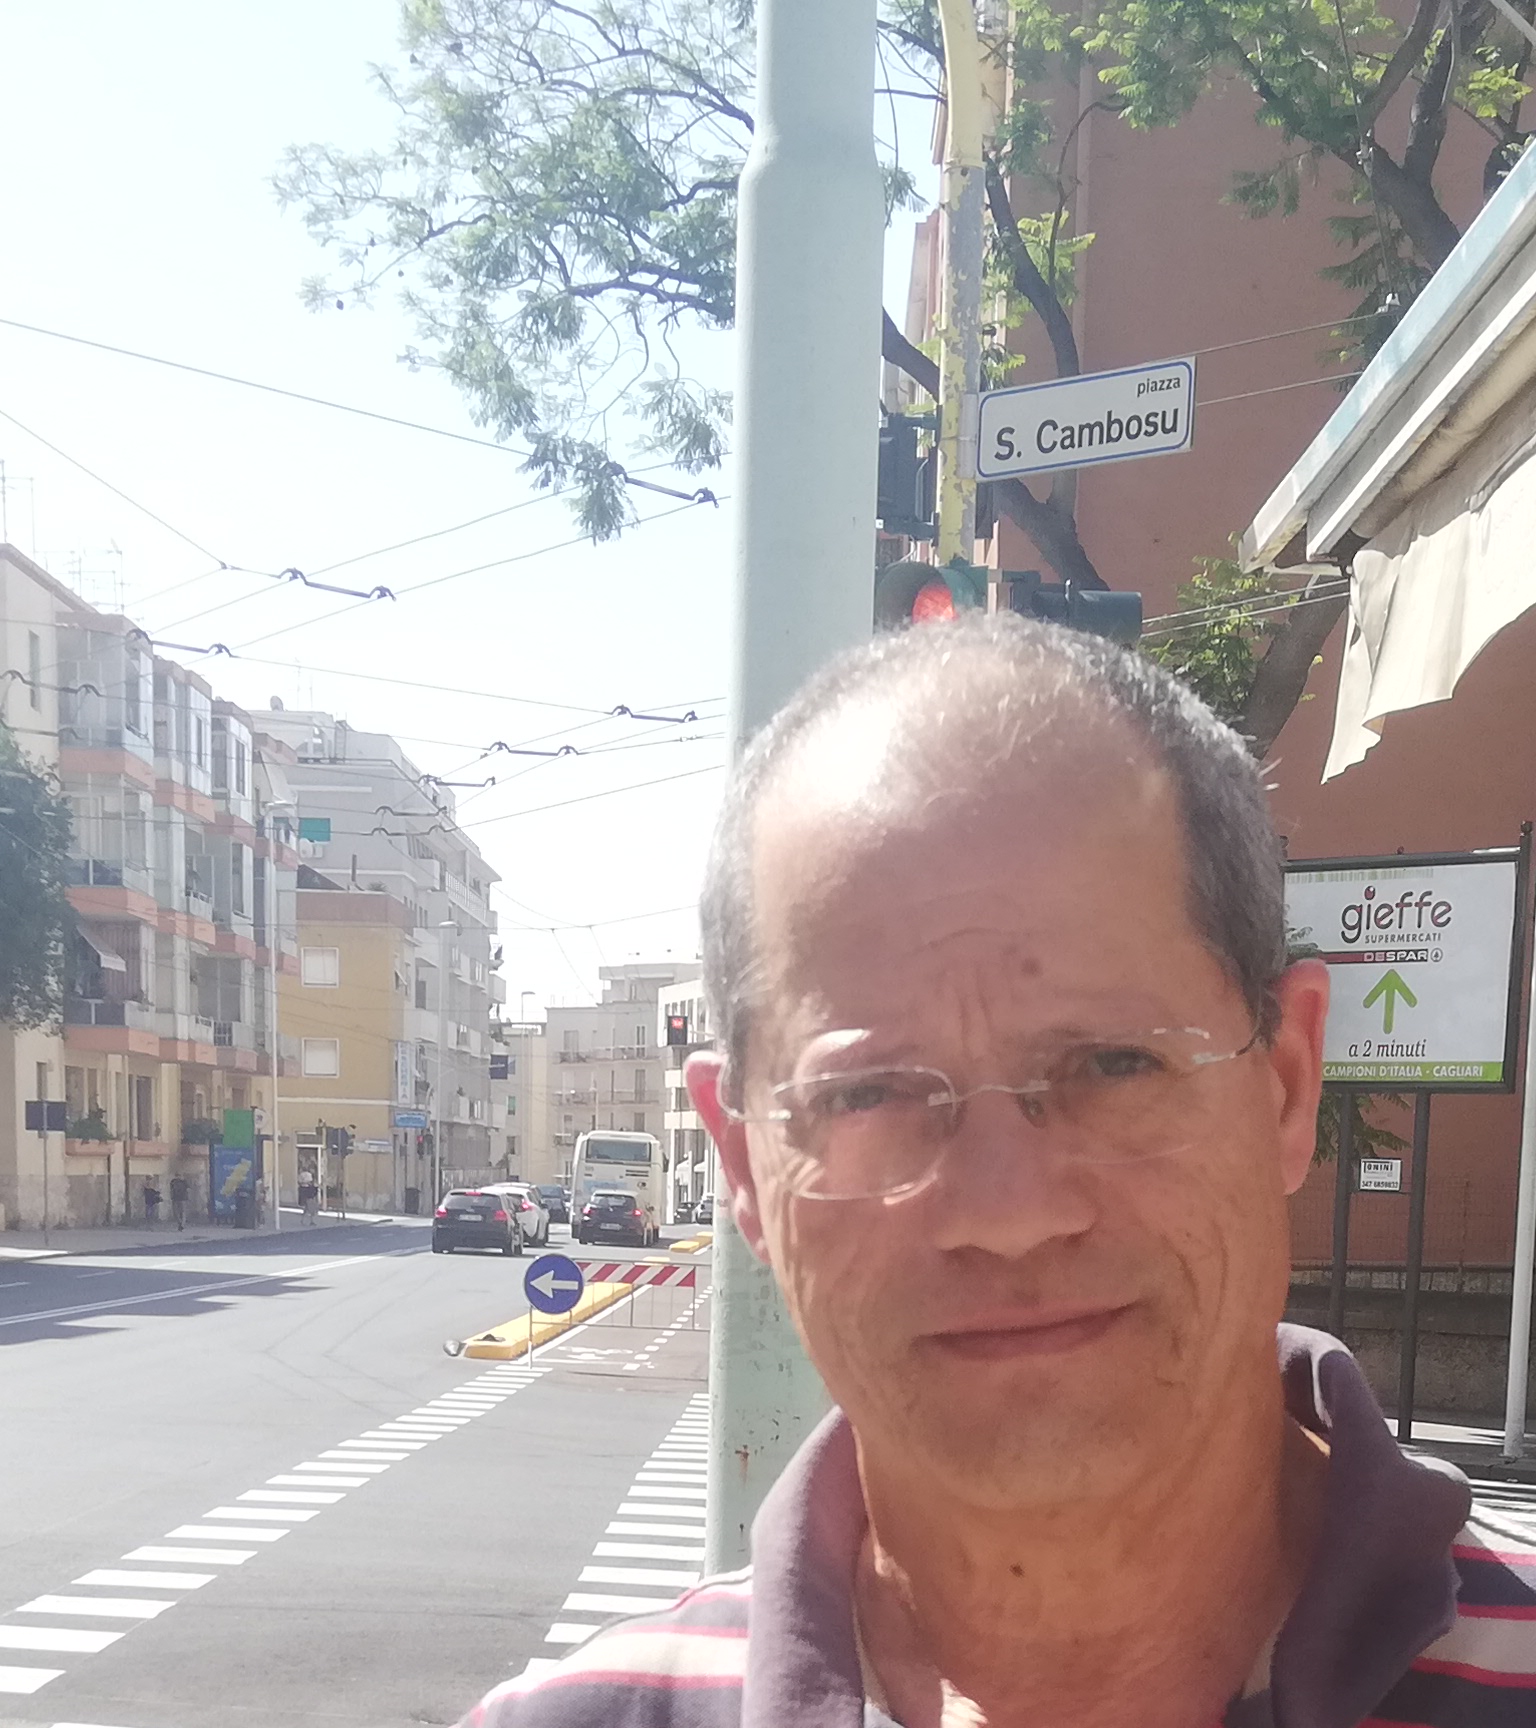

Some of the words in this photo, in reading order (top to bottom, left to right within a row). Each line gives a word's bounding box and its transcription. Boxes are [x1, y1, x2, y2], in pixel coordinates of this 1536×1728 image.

[1136, 376, 1181, 397] piazza
[994, 426, 1022, 461] S.
[1036, 408, 1179, 454] Cambosu
[1341, 885, 1452, 944] gieffe
[1365, 933, 1442, 944] SUPERMERCATI
[1364, 951, 1427, 962] DESPAR
[1349, 1044, 1359, 1057] a
[1363, 1040, 1372, 1057] 2
[1376, 1039, 1427, 1057] minuti
[1323, 1066, 1376, 1078] CAMPIONI
[1379, 1066, 1423, 1077] D'ITALIA
[1433, 1065, 1483, 1077] CAGLIARI
